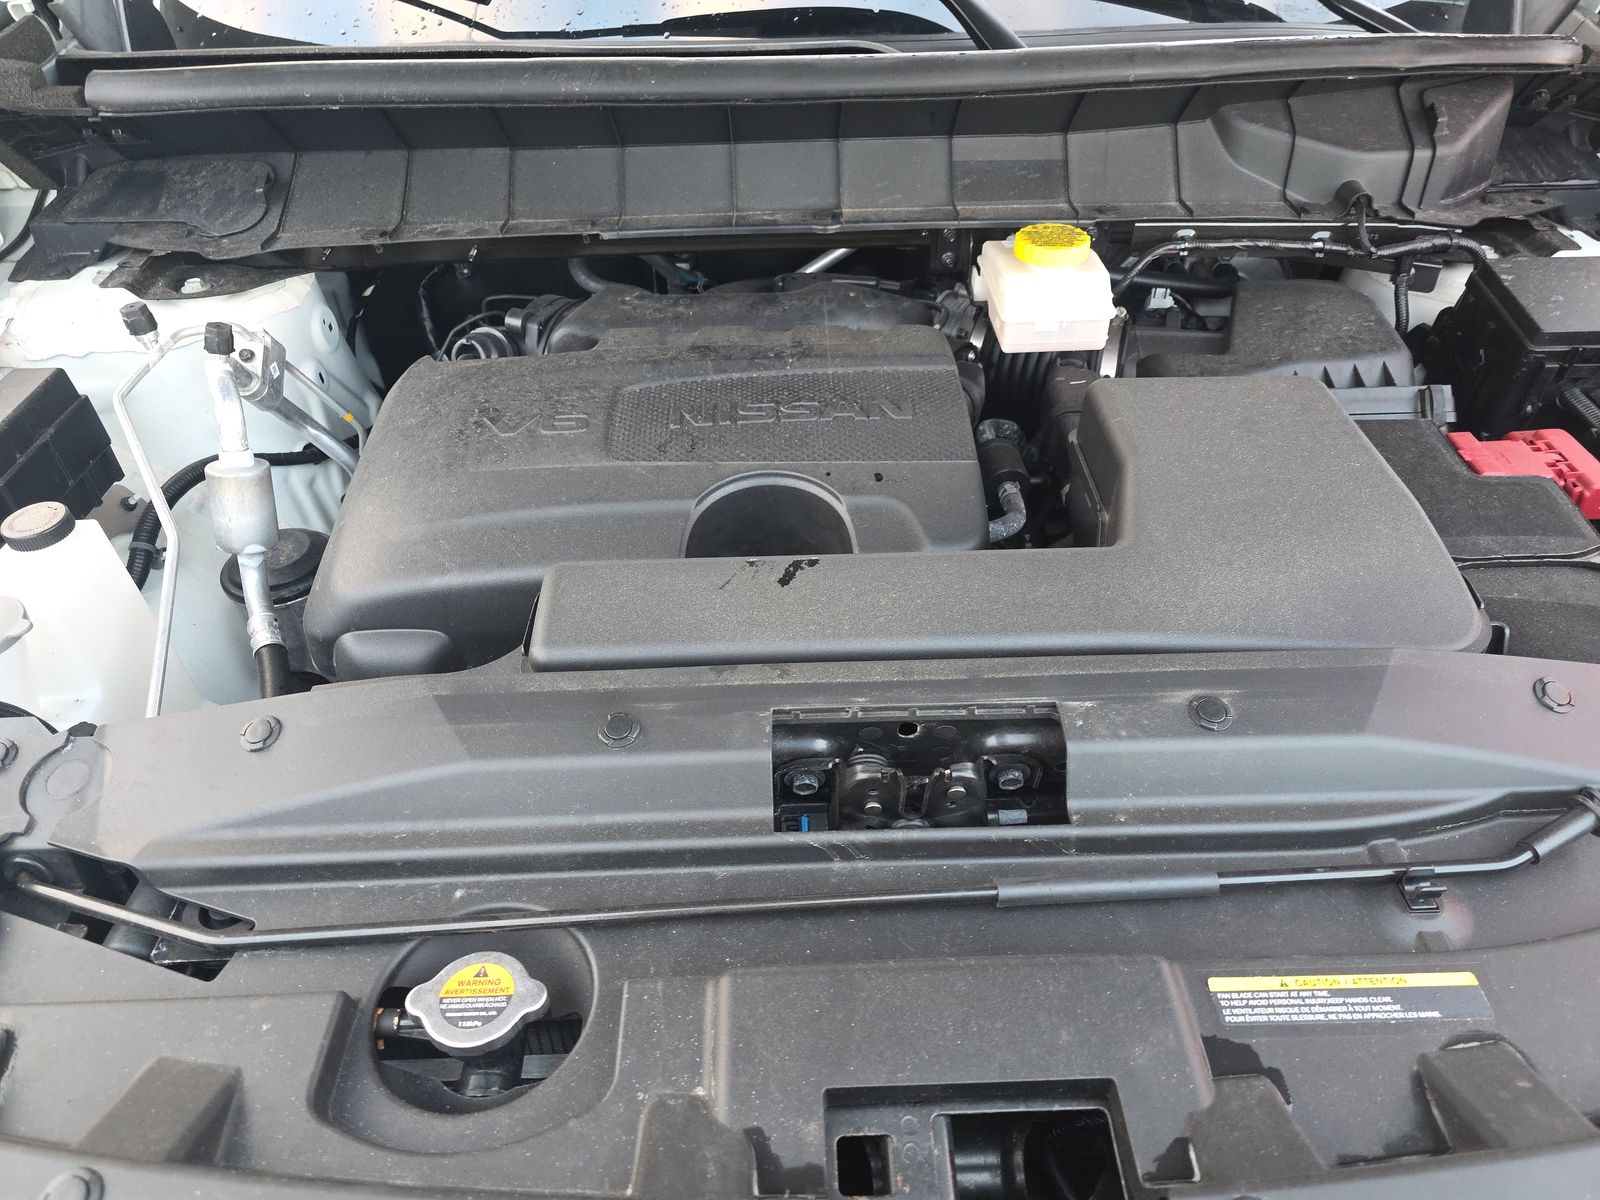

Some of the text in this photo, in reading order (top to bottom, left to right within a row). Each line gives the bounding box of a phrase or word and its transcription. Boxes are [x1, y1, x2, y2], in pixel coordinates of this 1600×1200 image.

[669, 400, 913, 429] NISSAN
[479, 407, 589, 436] V6
[457, 979, 502, 987] WARNING
[1294, 978, 1340, 987] CAUTION
[1352, 977, 1407, 985] ATTENTION
[444, 987, 510, 995] AVERTISSEMENT
[1232, 1007, 1274, 1015] VENTILATEUR
